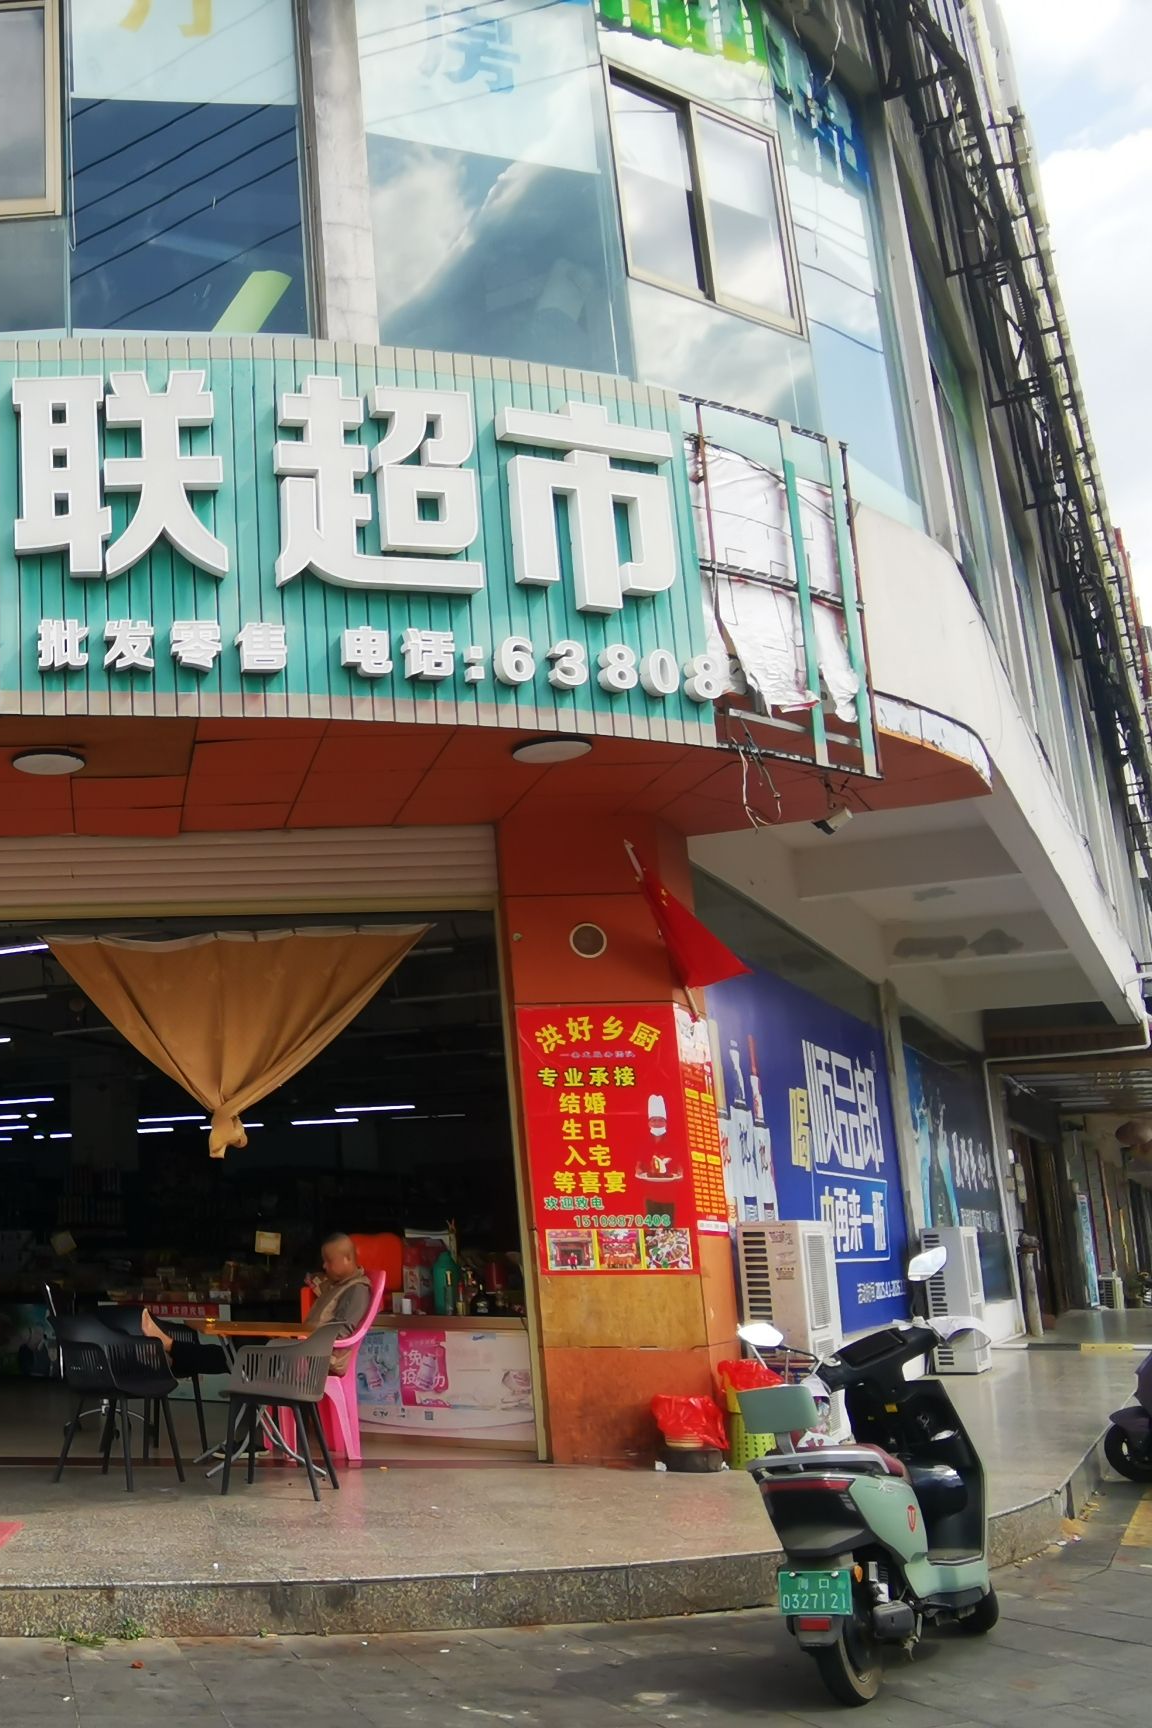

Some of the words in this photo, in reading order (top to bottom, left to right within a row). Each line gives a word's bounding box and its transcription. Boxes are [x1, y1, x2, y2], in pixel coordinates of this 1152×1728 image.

[535, 1016, 661, 1053] 洪好乡厨
[537, 1066, 636, 1088] 专业承接
[559, 1092, 606, 1115] 结婚
[562, 1119, 607, 1141] 生日
[564, 1144, 611, 1167] 入宅
[553, 1170, 627, 1194] 等喜宴
[544, 1196, 605, 1211] 欢迎致电
